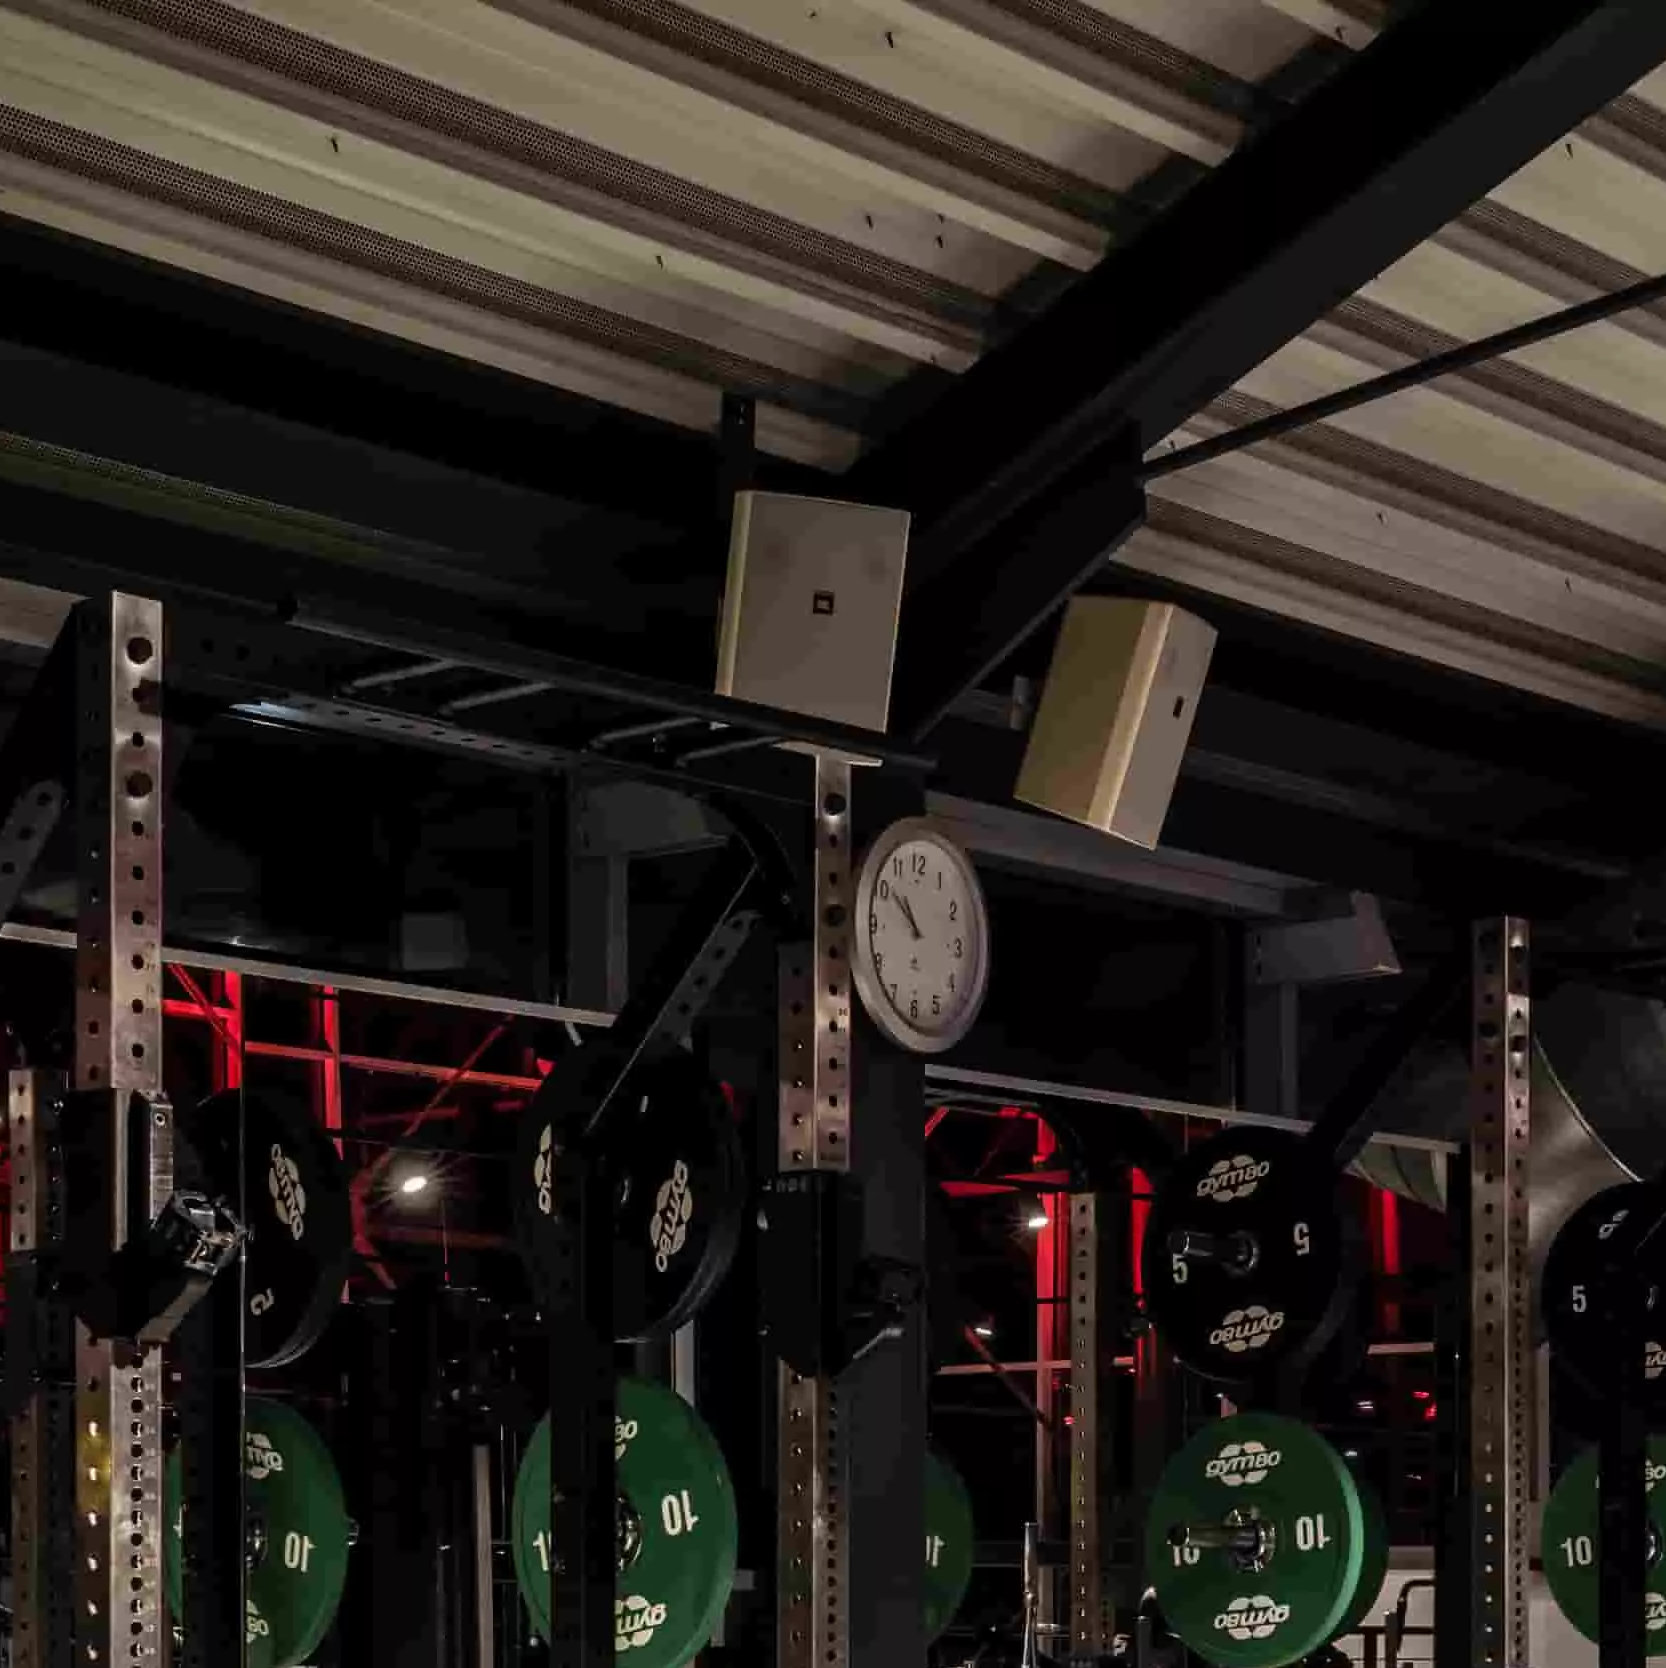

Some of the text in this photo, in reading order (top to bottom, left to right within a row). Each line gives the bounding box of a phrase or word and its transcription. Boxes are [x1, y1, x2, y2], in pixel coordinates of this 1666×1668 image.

[893, 857, 903, 877] 11
[912, 852, 926, 875] 12
[937, 871, 942, 889] 1
[949, 901, 957, 921] 2
[955, 938, 962, 959] 3
[889, 983, 898, 1000] 7
[933, 995, 941, 1015] 5
[1292, 1220, 1310, 1256] 5
[1172, 1252, 1189, 1285] 5
[1572, 1284, 1588, 1313] 5
[661, 1489, 700, 1536] 10
[1298, 1512, 1333, 1551] 10
[533, 1529, 552, 1572] 1
[1559, 1535, 1594, 1569] 10
